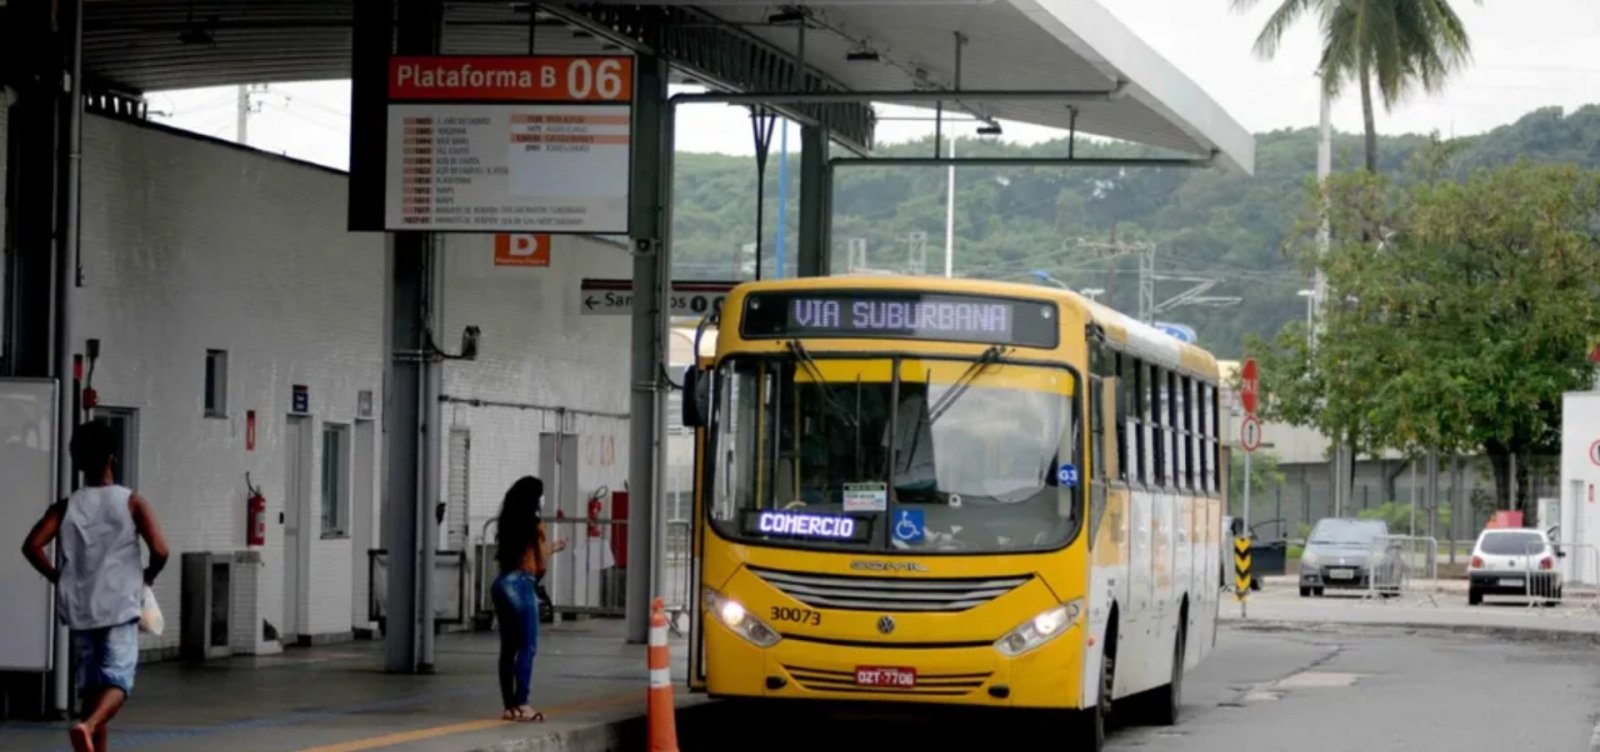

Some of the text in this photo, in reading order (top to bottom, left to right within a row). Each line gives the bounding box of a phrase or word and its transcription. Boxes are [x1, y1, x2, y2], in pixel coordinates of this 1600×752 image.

[397, 59, 622, 99] Plataforma B 06
[795, 299, 1007, 332] VIA SUBURBANA
[1058, 469, 1078, 481] G3
[759, 512, 853, 537] COMERCIO
[770, 606, 822, 626] 30073
